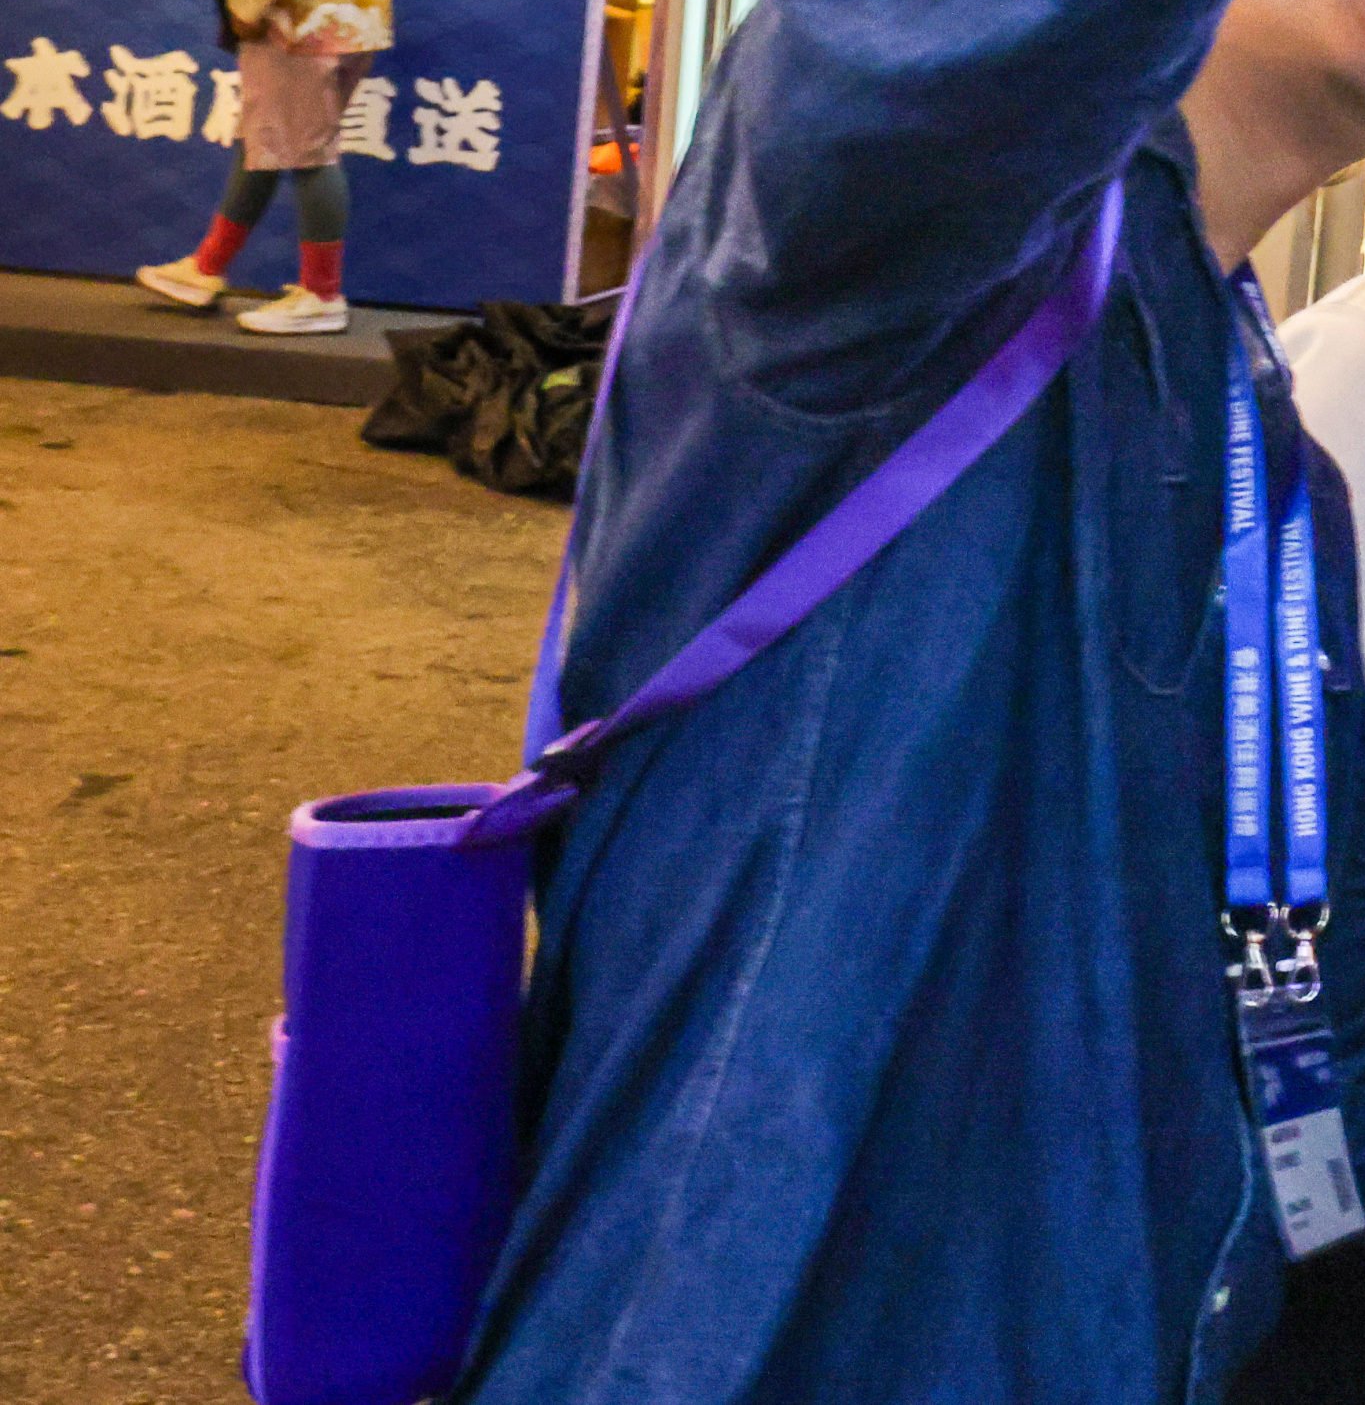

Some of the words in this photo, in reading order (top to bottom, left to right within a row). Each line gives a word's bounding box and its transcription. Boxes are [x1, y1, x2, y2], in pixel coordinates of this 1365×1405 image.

[1229, 446, 1256, 534] FESTIVAL
[1282, 605, 1309, 650] DINE
[1286, 671, 1313, 725] WINE
[1288, 726, 1316, 780] KONG
[1293, 783, 1318, 837] HONG
